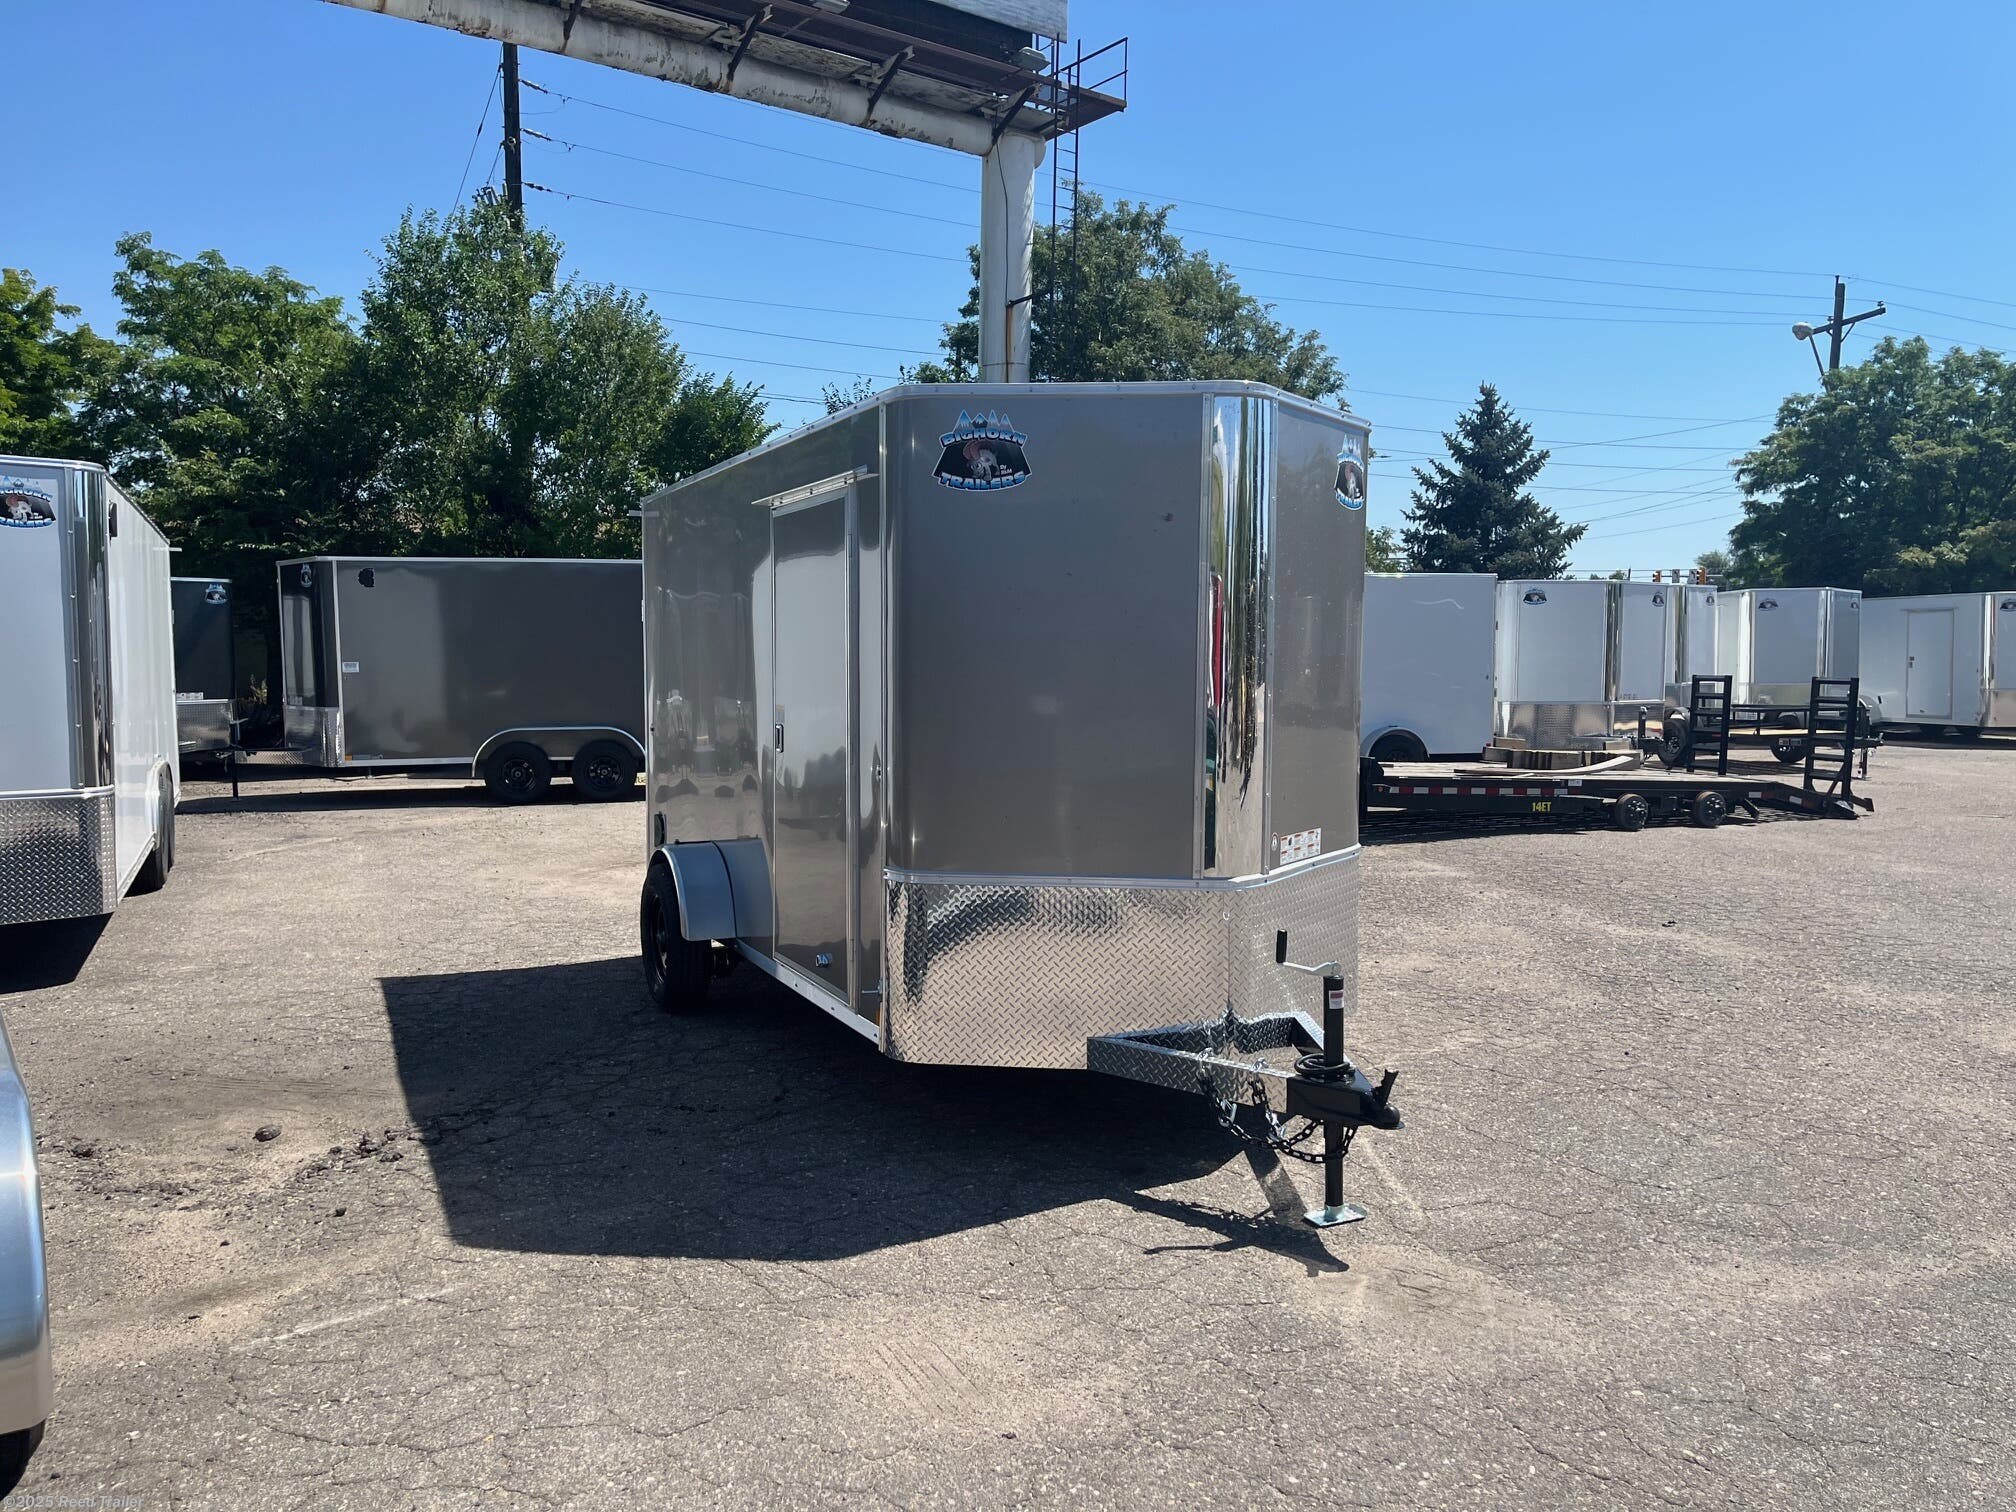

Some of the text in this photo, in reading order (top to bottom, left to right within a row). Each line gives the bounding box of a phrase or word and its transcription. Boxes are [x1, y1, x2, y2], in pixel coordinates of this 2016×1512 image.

[940, 427, 1027, 447] BIGHORN
[941, 471, 1026, 490] TRAILERS
[1531, 801, 1552, 812] 14ET
